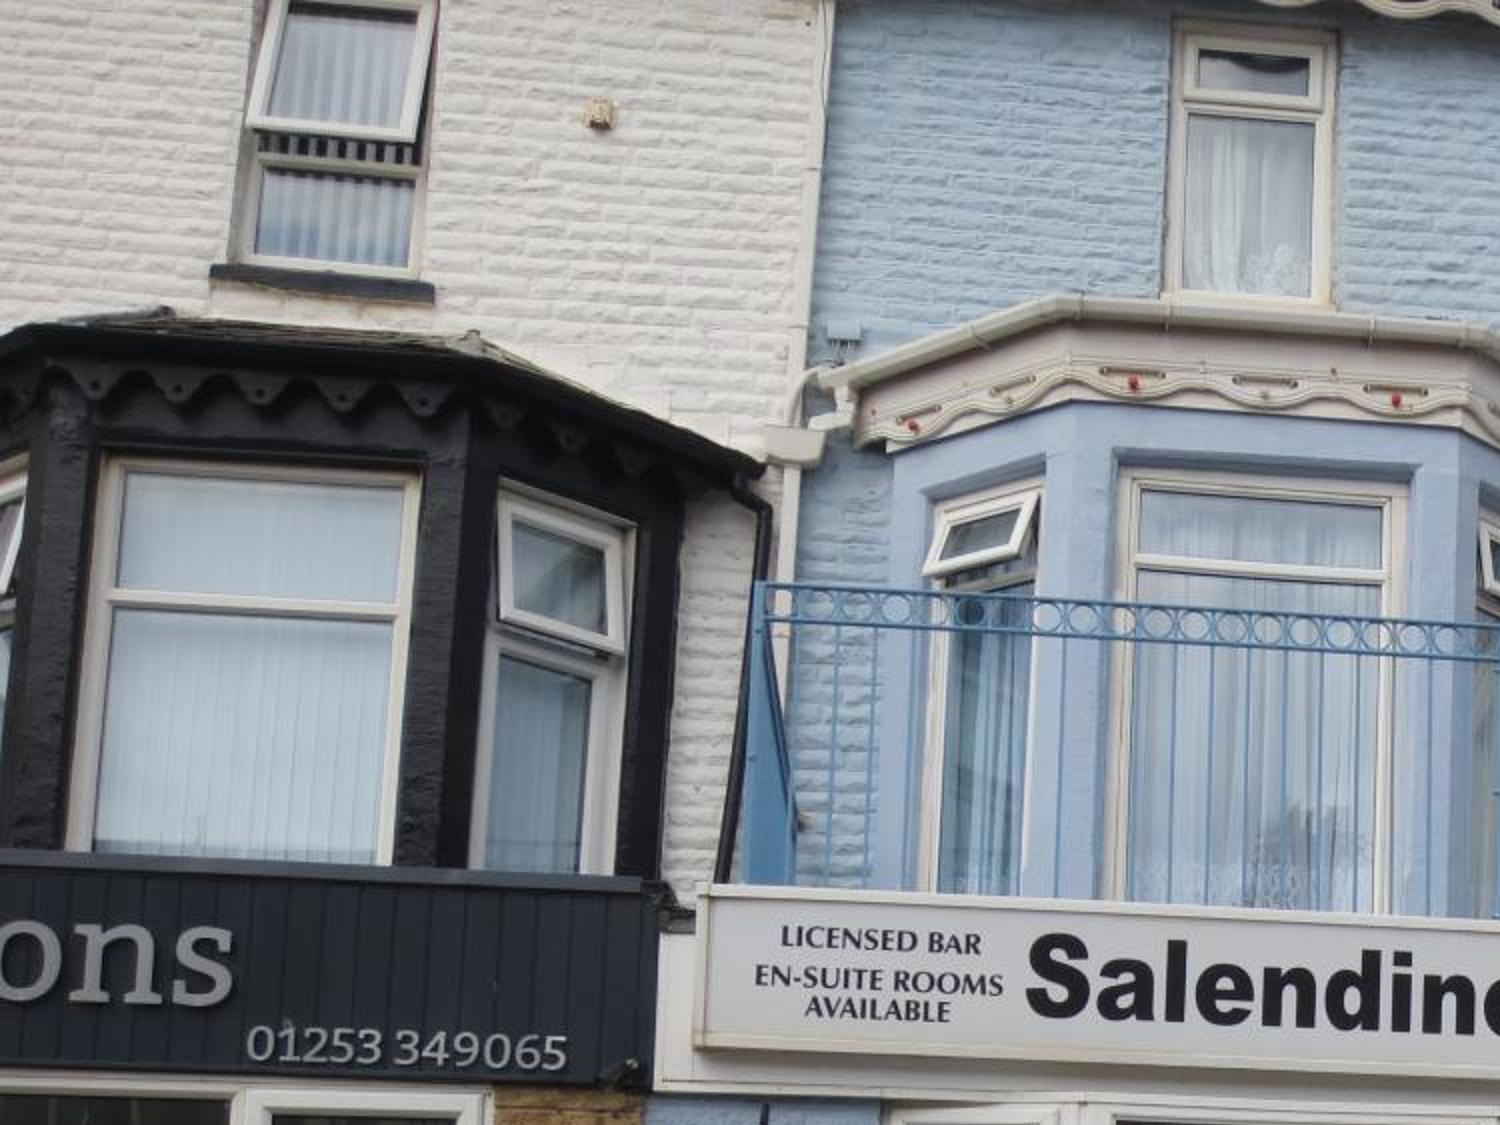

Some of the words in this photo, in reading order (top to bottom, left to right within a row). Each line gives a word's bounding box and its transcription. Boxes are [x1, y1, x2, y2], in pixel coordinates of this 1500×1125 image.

[781, 925, 918, 952] LICENSED
[927, 932, 982, 955] BAR
[755, 964, 884, 991] EN-SUITE
[893, 970, 1004, 996] ROOMS
[804, 996, 951, 1023] AVAILABLE
[246, 1023, 382, 1066] 01253
[393, 1027, 568, 1072] 349065
